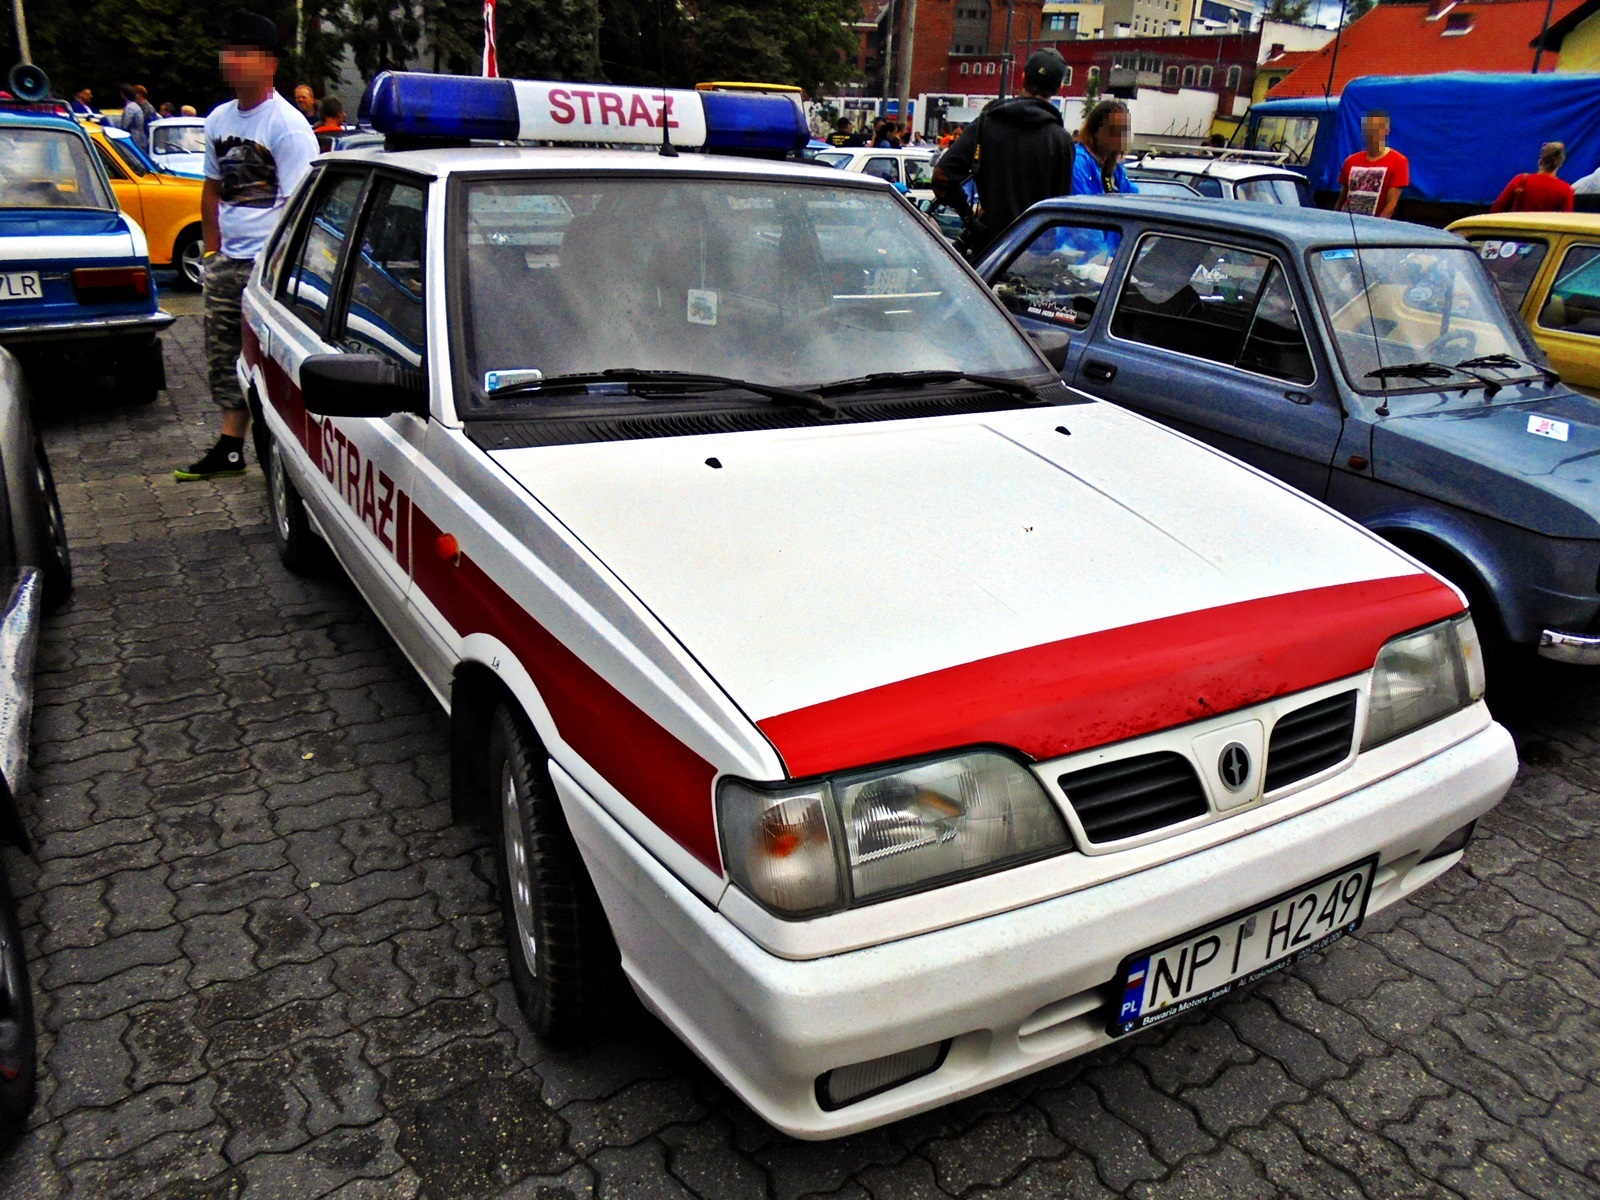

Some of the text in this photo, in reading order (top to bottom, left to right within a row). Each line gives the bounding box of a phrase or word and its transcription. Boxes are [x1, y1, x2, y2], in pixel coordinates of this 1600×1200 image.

[323, 417, 394, 554] STRAŻ
[1265, 872, 1363, 960] H249
[1120, 1000, 1137, 1017] PL
[1142, 1006, 1178, 1026] Bawaria
[1178, 995, 1208, 1013] Motors
[1208, 984, 1232, 1001] Janki
